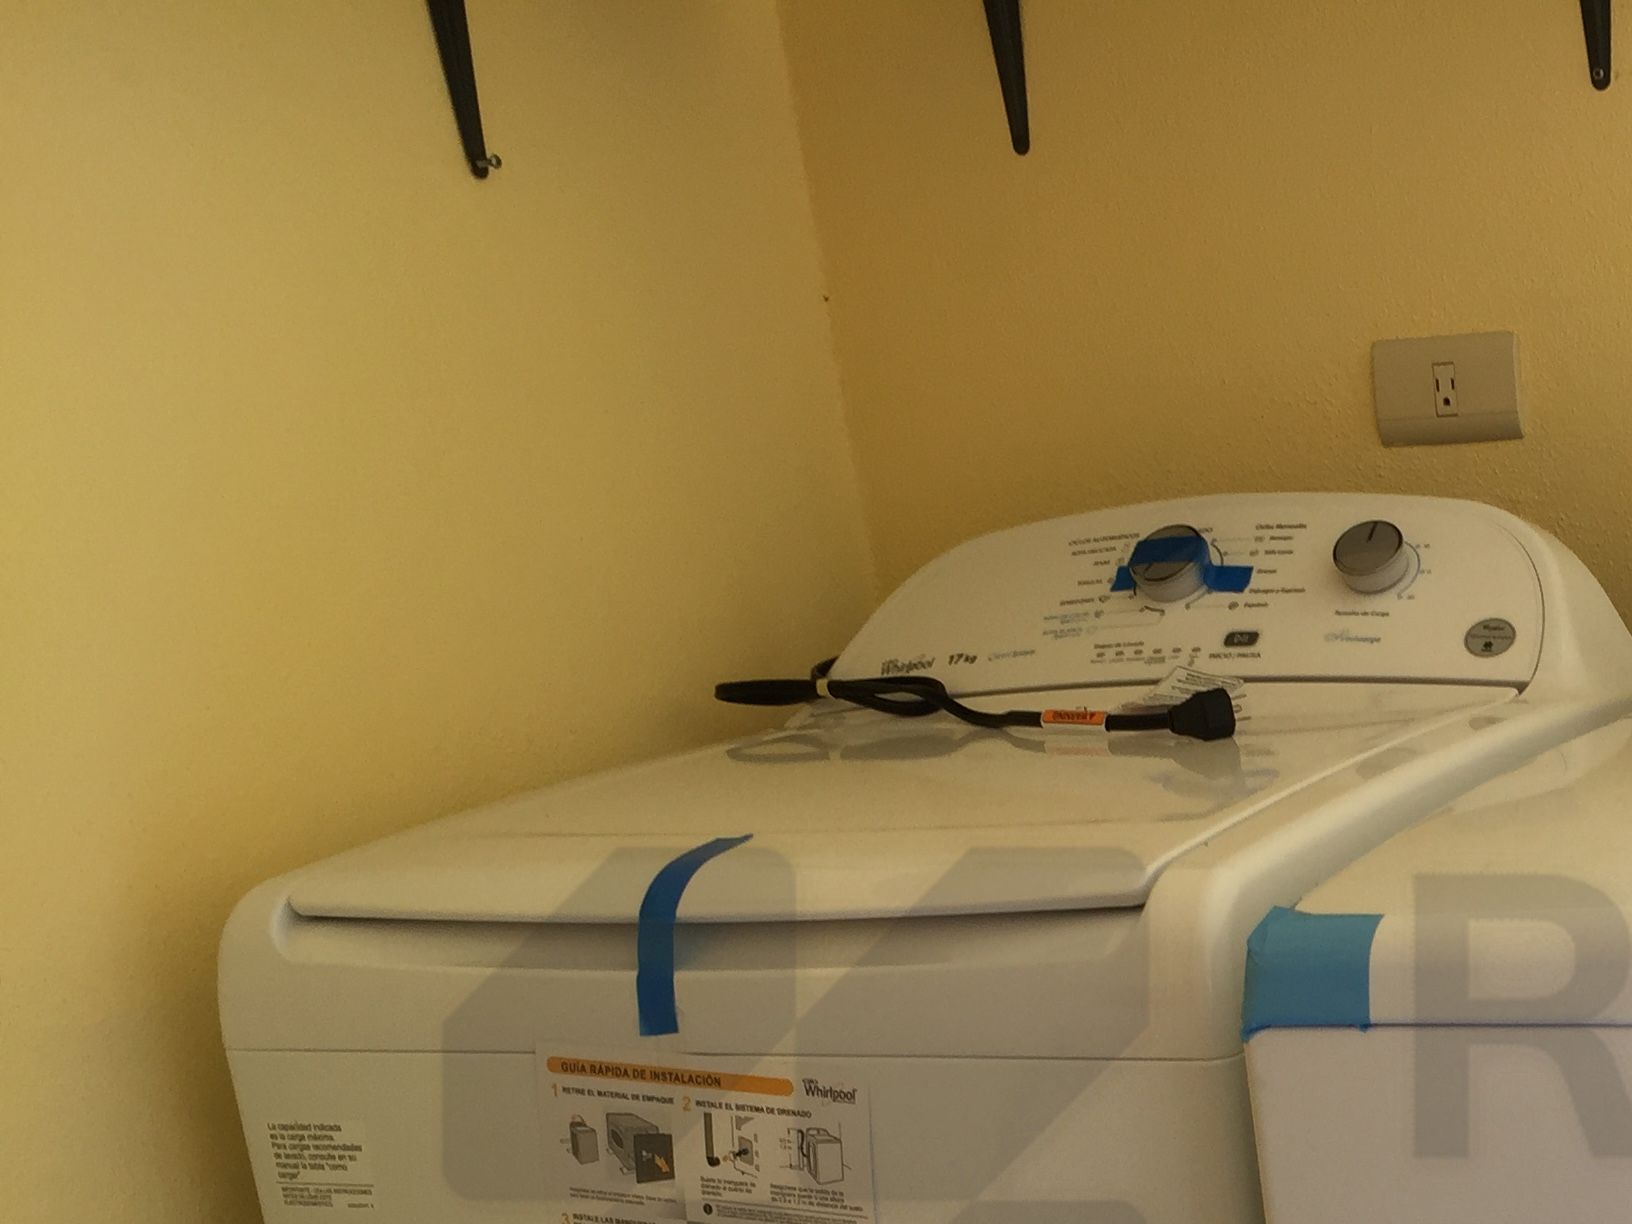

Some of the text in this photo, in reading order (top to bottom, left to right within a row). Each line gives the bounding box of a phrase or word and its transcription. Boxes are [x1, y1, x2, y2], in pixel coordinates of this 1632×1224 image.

[948, 652, 962, 666] 17
[962, 653, 979, 665] kg
[560, 1060, 722, 1088] GUÍA RÁPIDA DE INSTALACIÓN
[551, 1082, 559, 1096] 1
[803, 1081, 858, 1103] Whirlpool
[682, 1095, 692, 1112] 2
